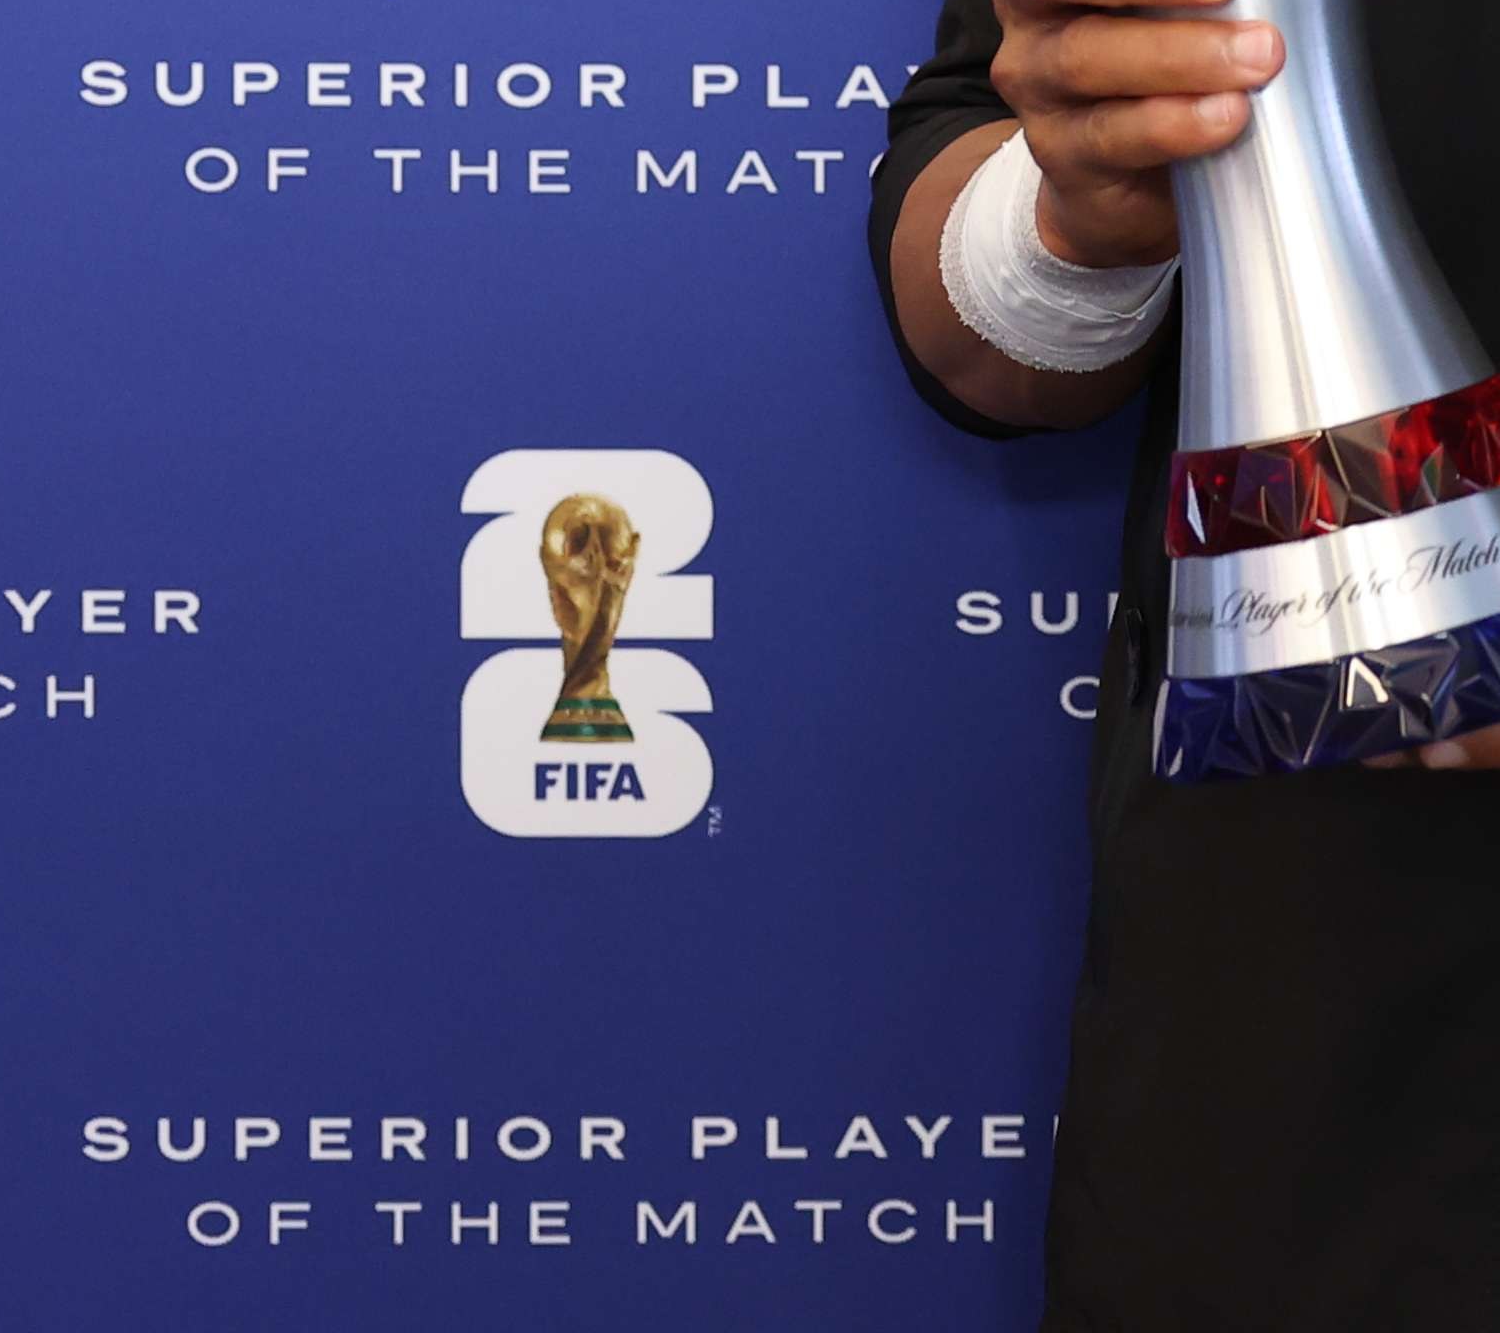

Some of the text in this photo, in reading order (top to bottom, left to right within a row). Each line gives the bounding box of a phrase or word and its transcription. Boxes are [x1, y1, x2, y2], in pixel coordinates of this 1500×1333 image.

[79, 59, 918, 109] SUPERIOR PLA
[184, 146, 886, 195] OF THE MAT
[1400, 532, 1500, 591] Match
[535, 762, 644, 800] FIFA
[81, 1114, 1061, 1163] SUPERIOR PLAYE
[186, 1198, 995, 1247] OF THE MATCH
